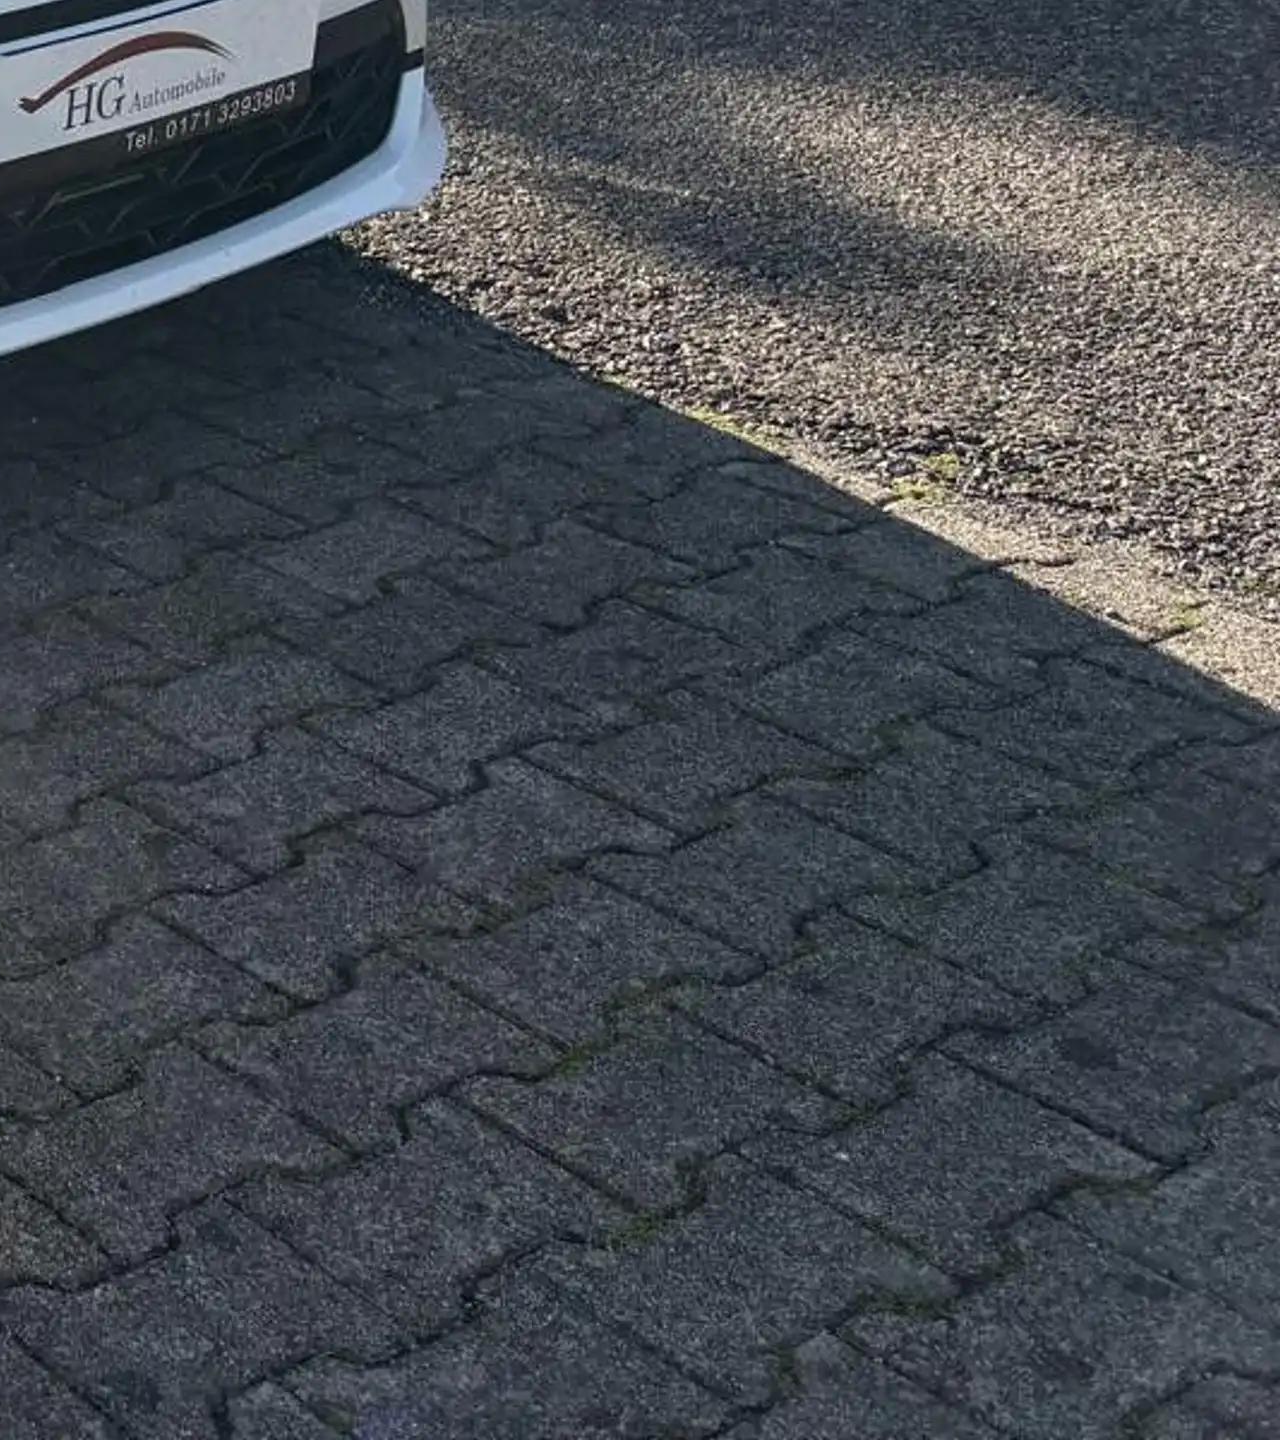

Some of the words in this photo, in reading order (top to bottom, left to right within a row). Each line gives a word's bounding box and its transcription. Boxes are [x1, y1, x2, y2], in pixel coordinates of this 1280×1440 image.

[62, 75, 126, 131] HG
[130, 66, 227, 115] Automobile
[125, 127, 159, 153] Tel.
[165, 112, 212, 140] 0171
